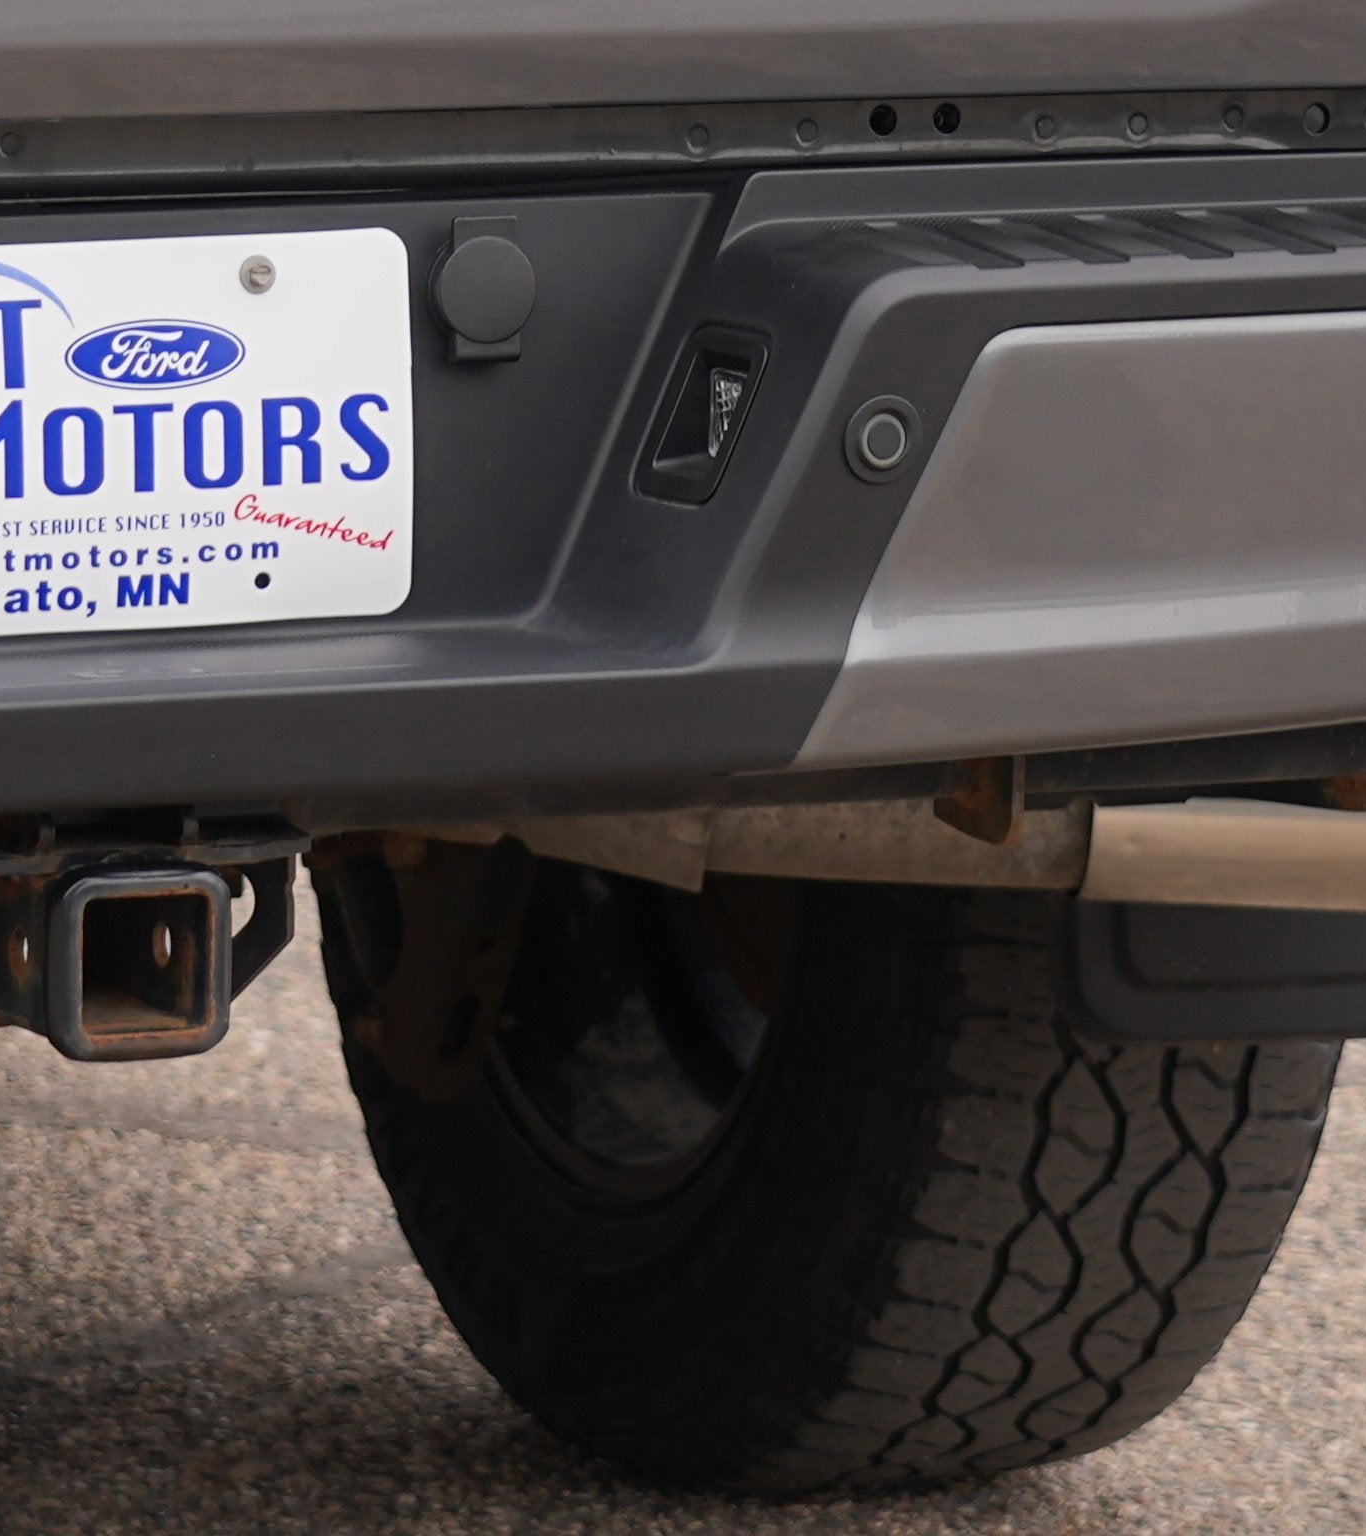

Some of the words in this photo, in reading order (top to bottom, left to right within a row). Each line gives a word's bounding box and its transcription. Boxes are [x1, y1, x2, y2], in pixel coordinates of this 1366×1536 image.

[101, 329, 210, 379] Ford
[29, 516, 107, 536] SERVICE
[115, 513, 170, 532] SINCE
[180, 511, 226, 529] 1950
[233, 494, 395, 551] Guaranteed
[117, 571, 191, 608] MN
